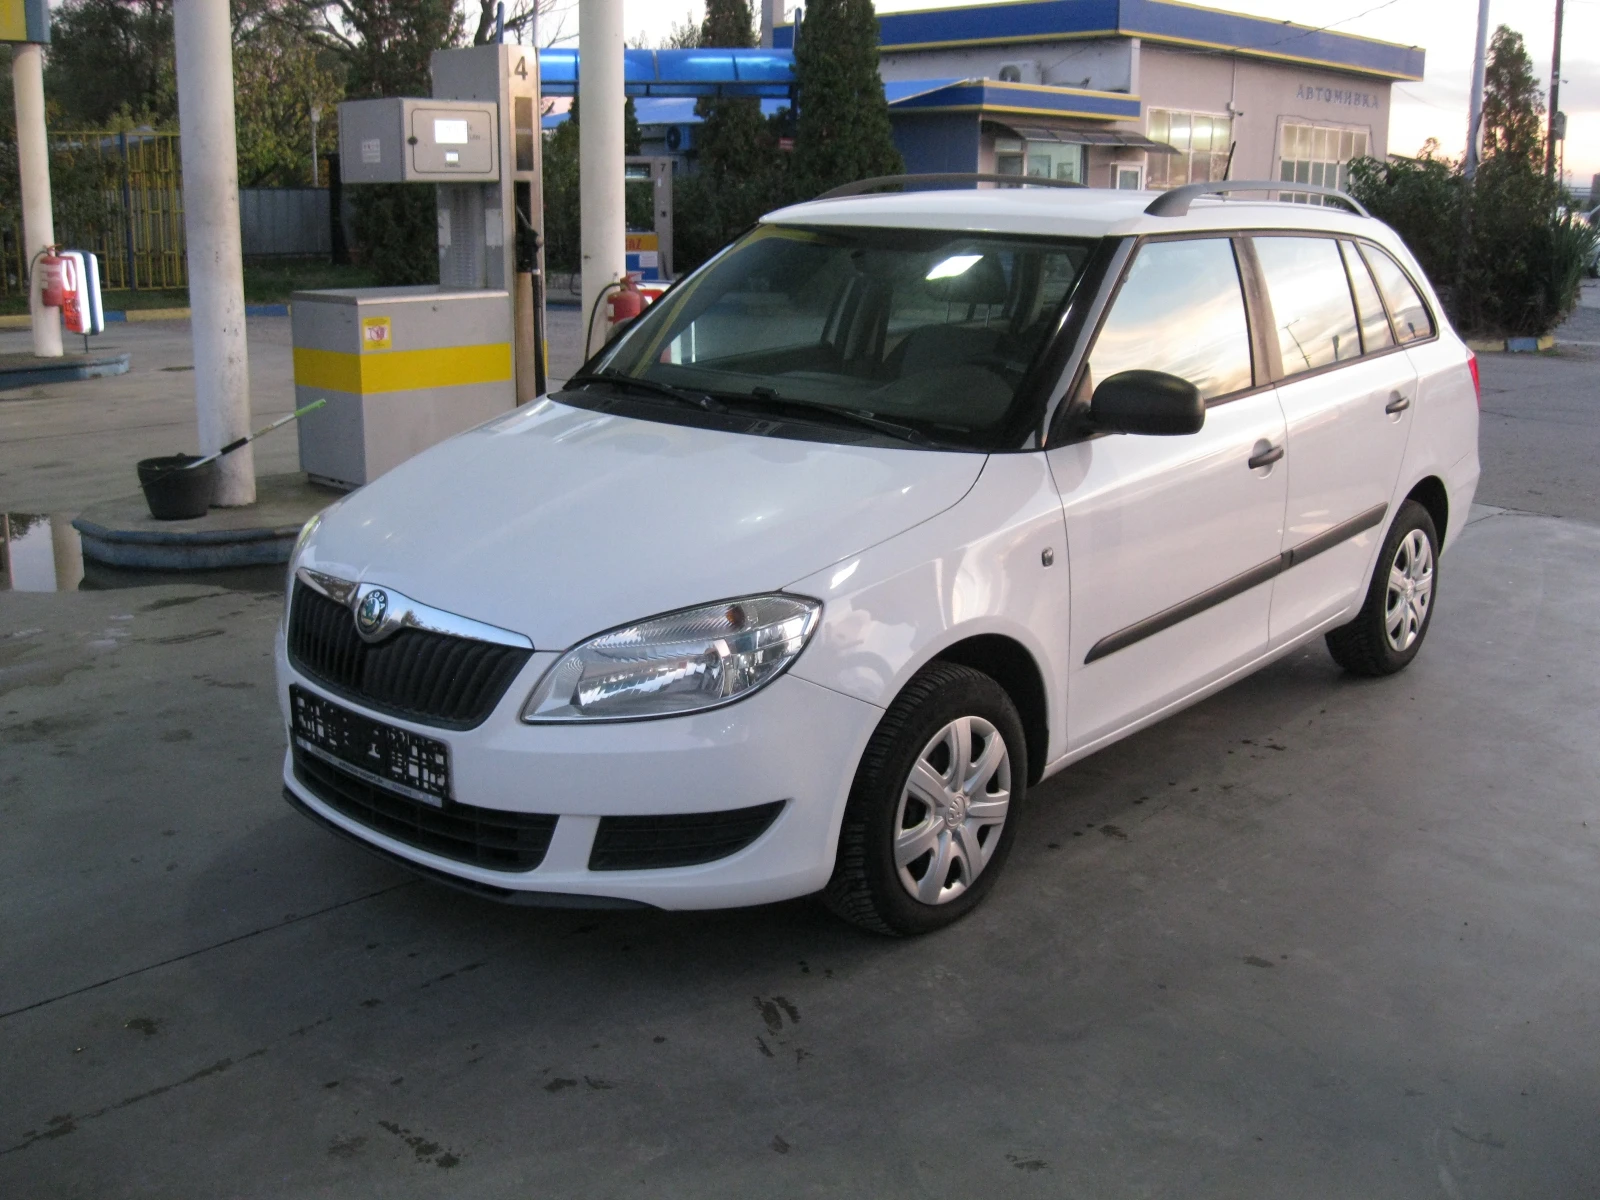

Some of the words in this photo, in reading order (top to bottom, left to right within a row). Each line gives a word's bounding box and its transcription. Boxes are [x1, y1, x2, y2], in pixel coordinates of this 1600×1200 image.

[514, 56, 528, 80] 4
[1296, 84, 1379, 109] АВТОМИВКА
[660, 163, 666, 171] 7
